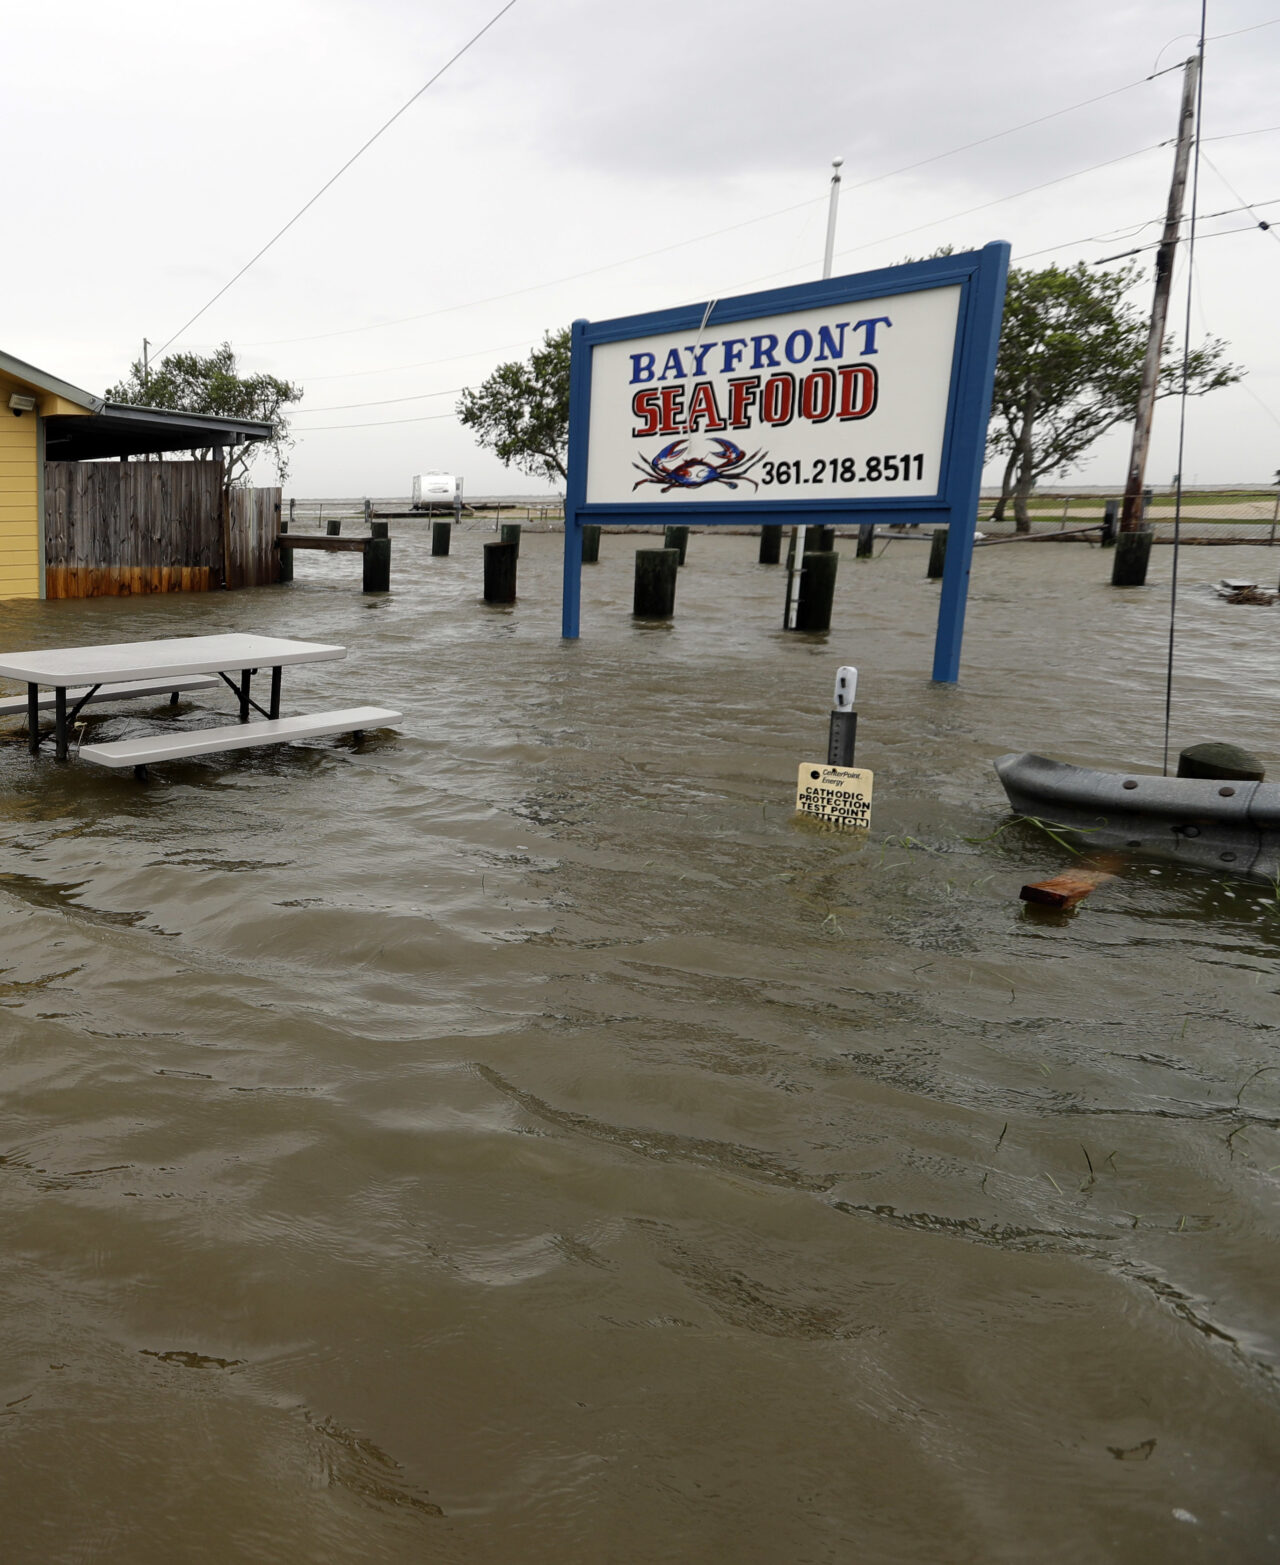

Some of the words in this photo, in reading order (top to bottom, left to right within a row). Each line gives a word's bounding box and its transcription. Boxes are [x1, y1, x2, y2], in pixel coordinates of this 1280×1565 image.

[629, 316, 892, 385] BAYFRONT
[631, 362, 879, 438] SEAFOOD
[822, 769, 861, 779] CenterPoint
[822, 777, 844, 787] Energy
[799, 793, 871, 810] PROTECTION
[805, 786, 864, 801] CATHODIC
[801, 801, 827, 812] TEST
[831, 806, 867, 817] POINT
